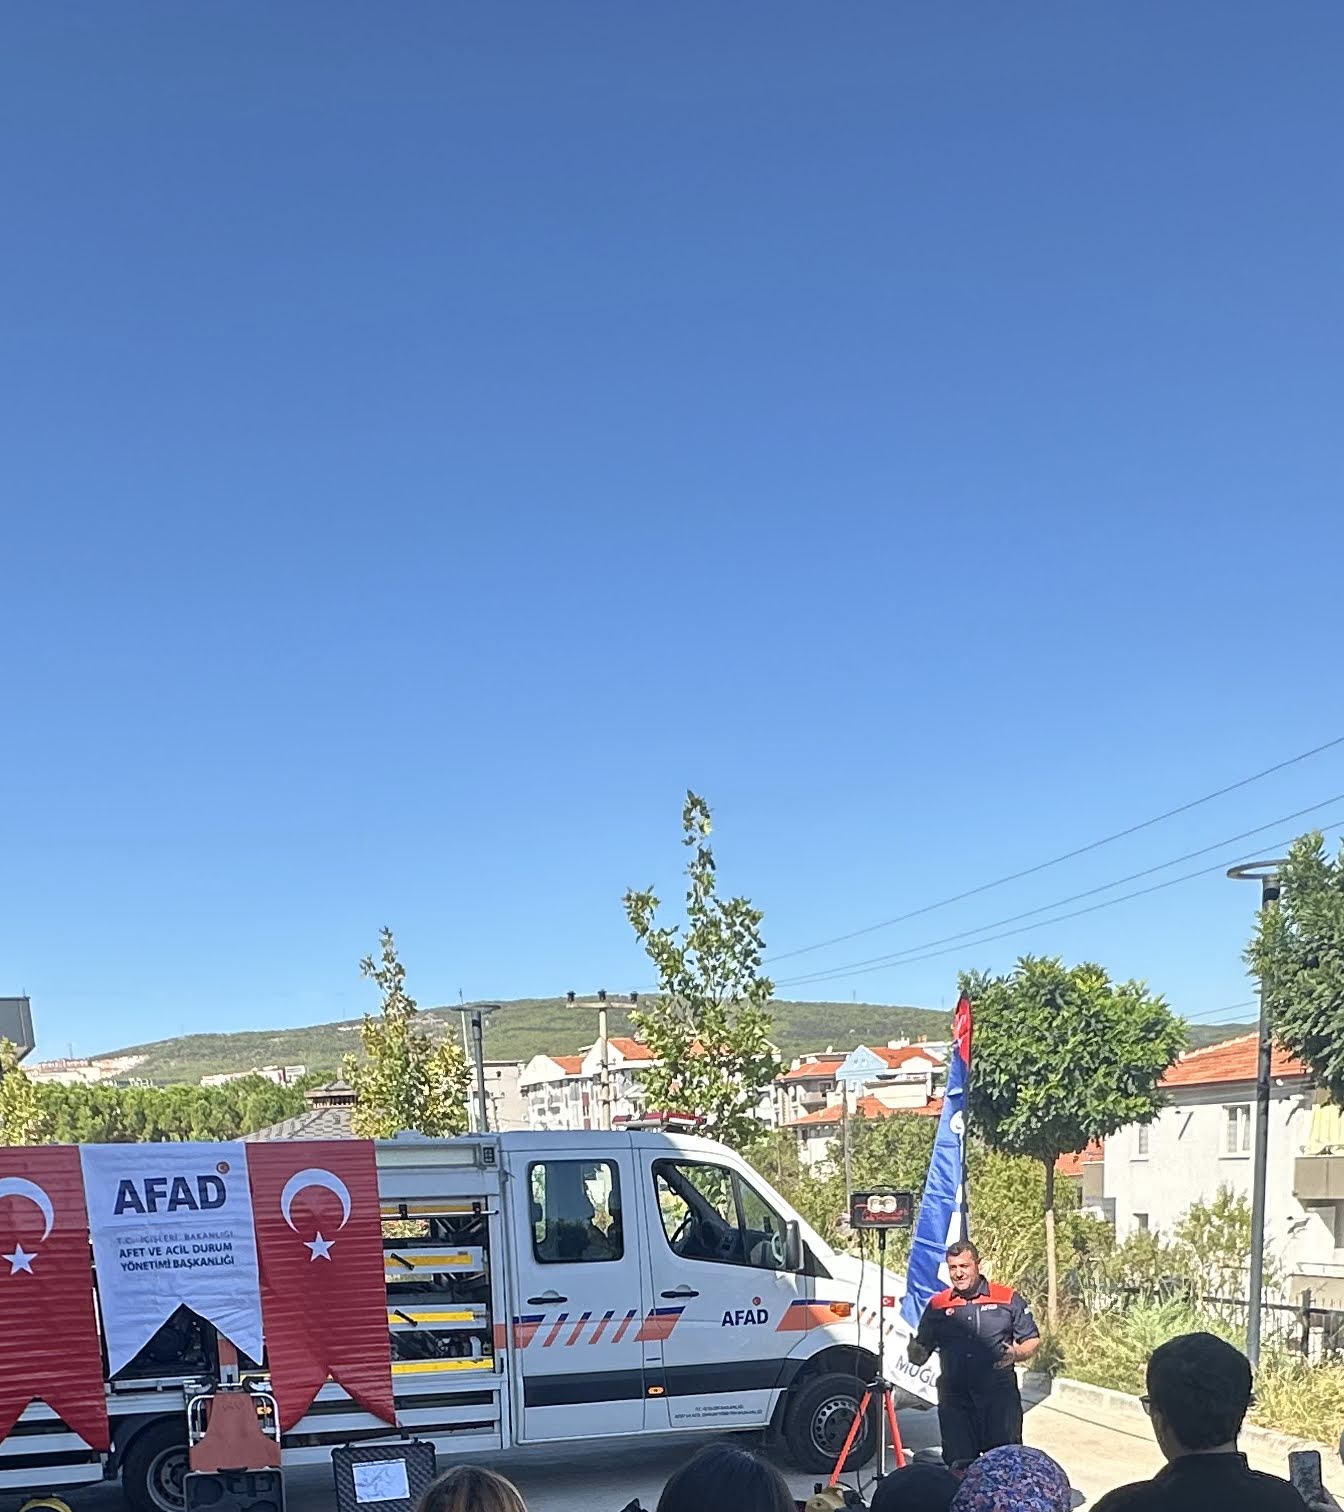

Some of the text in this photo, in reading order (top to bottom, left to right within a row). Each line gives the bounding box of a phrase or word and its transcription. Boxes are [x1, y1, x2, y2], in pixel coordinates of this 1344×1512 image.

[113, 1174, 227, 1215] AFAD
[119, 1242, 233, 1258] AFET VE ACİL DURUM
[120, 1254, 235, 1272] YÖNETİMİ BAŞKANLIĞI
[721, 1309, 769, 1327] AFAD
[895, 1355, 937, 1388] MUĞL
